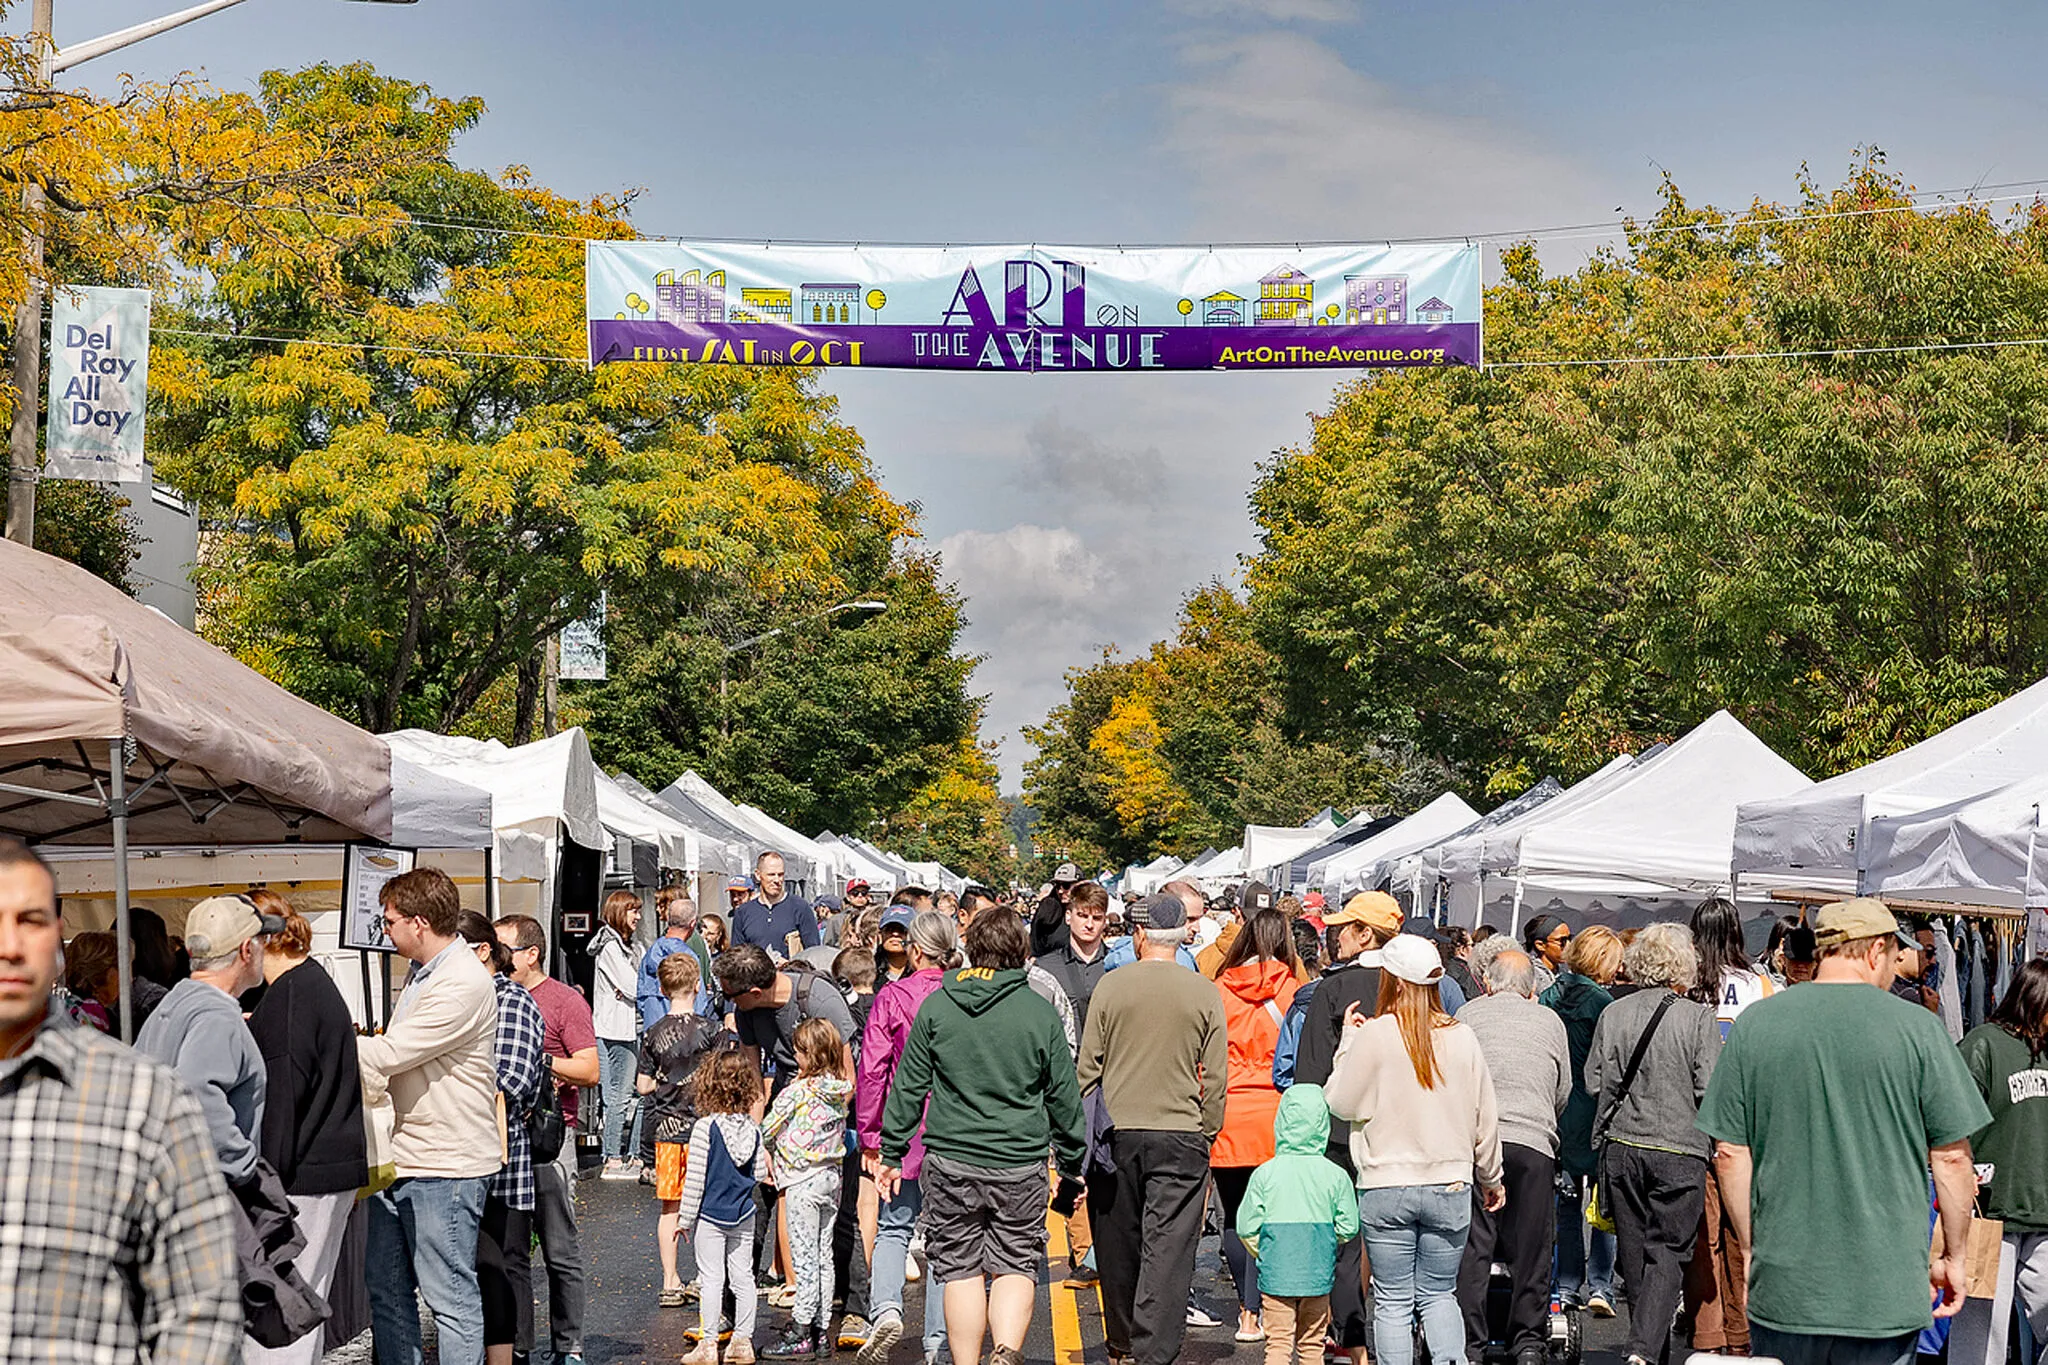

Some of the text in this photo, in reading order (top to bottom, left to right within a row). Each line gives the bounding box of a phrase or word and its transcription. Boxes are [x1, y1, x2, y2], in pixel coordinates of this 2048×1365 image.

[942, 259, 1138, 327] ART ON
[66, 324, 113, 350] Del
[911, 332, 1165, 368] THE AVENUE
[633, 346, 690, 361] FIRST
[699, 338, 759, 365] SAT
[789, 339, 865, 366] OCT
[1218, 345, 1445, 363] ArtOnTheAvenue.org
[80, 349, 137, 383] Ray
[63, 375, 101, 401] All
[72, 401, 132, 435] Day
[955, 966, 996, 983] GMU
[1723, 983, 1738, 1005] A
